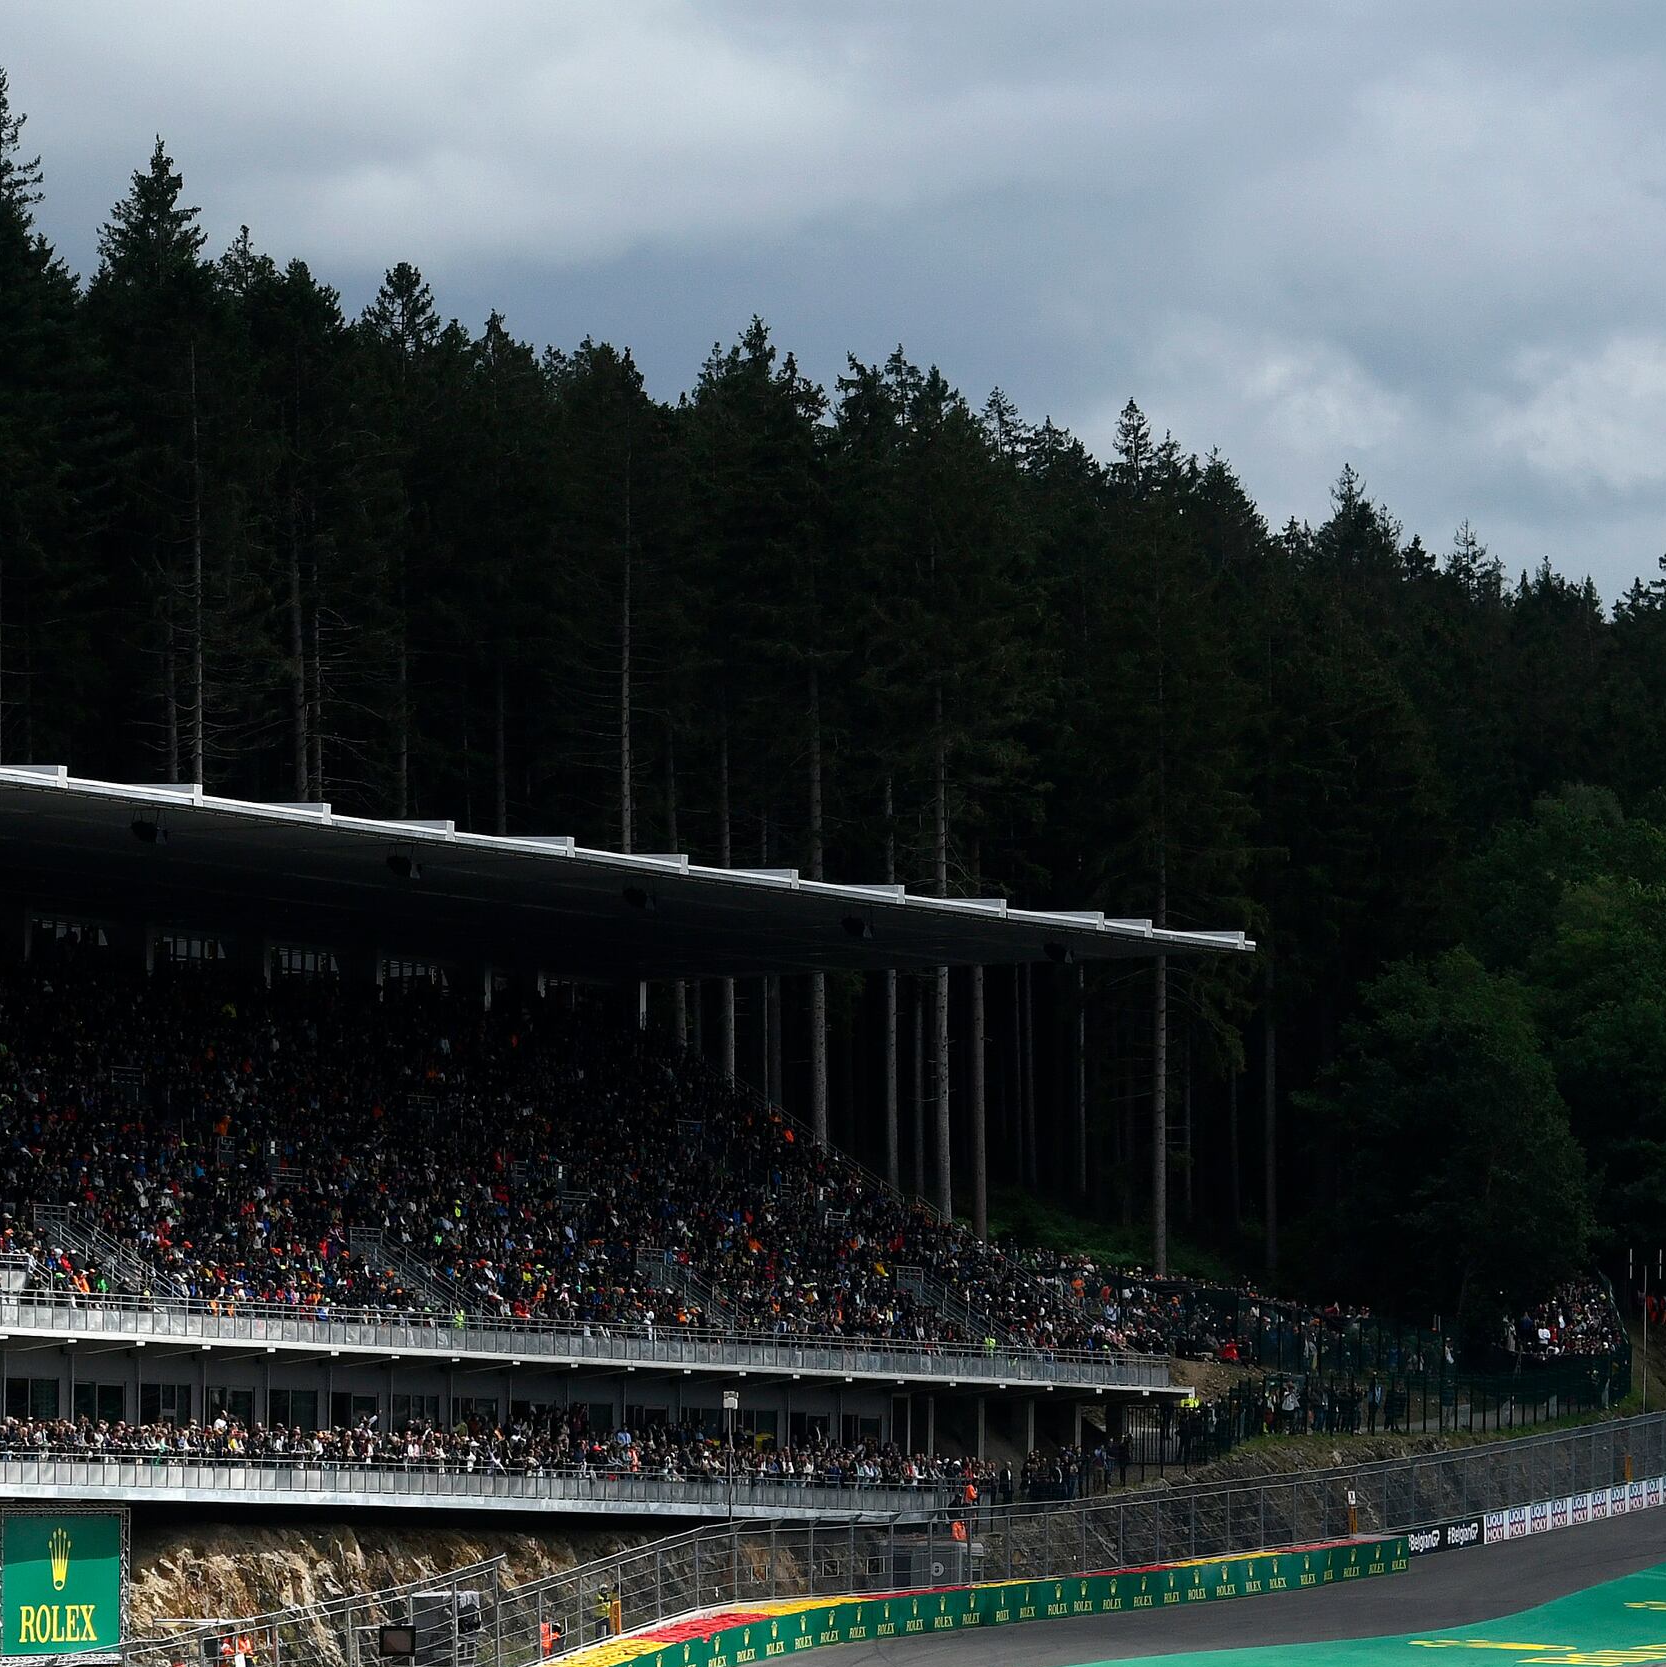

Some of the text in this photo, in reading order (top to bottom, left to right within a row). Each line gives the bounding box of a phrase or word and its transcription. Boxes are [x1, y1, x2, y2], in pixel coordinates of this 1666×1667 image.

[1509, 1508, 1525, 1521] LIQUI
[1531, 1504, 1546, 1517] LIQUI
[1486, 1512, 1503, 1526] LIQUI
[1447, 1523, 1479, 1545] #BelgianGP
[19, 1605, 97, 1643] ROLEX
